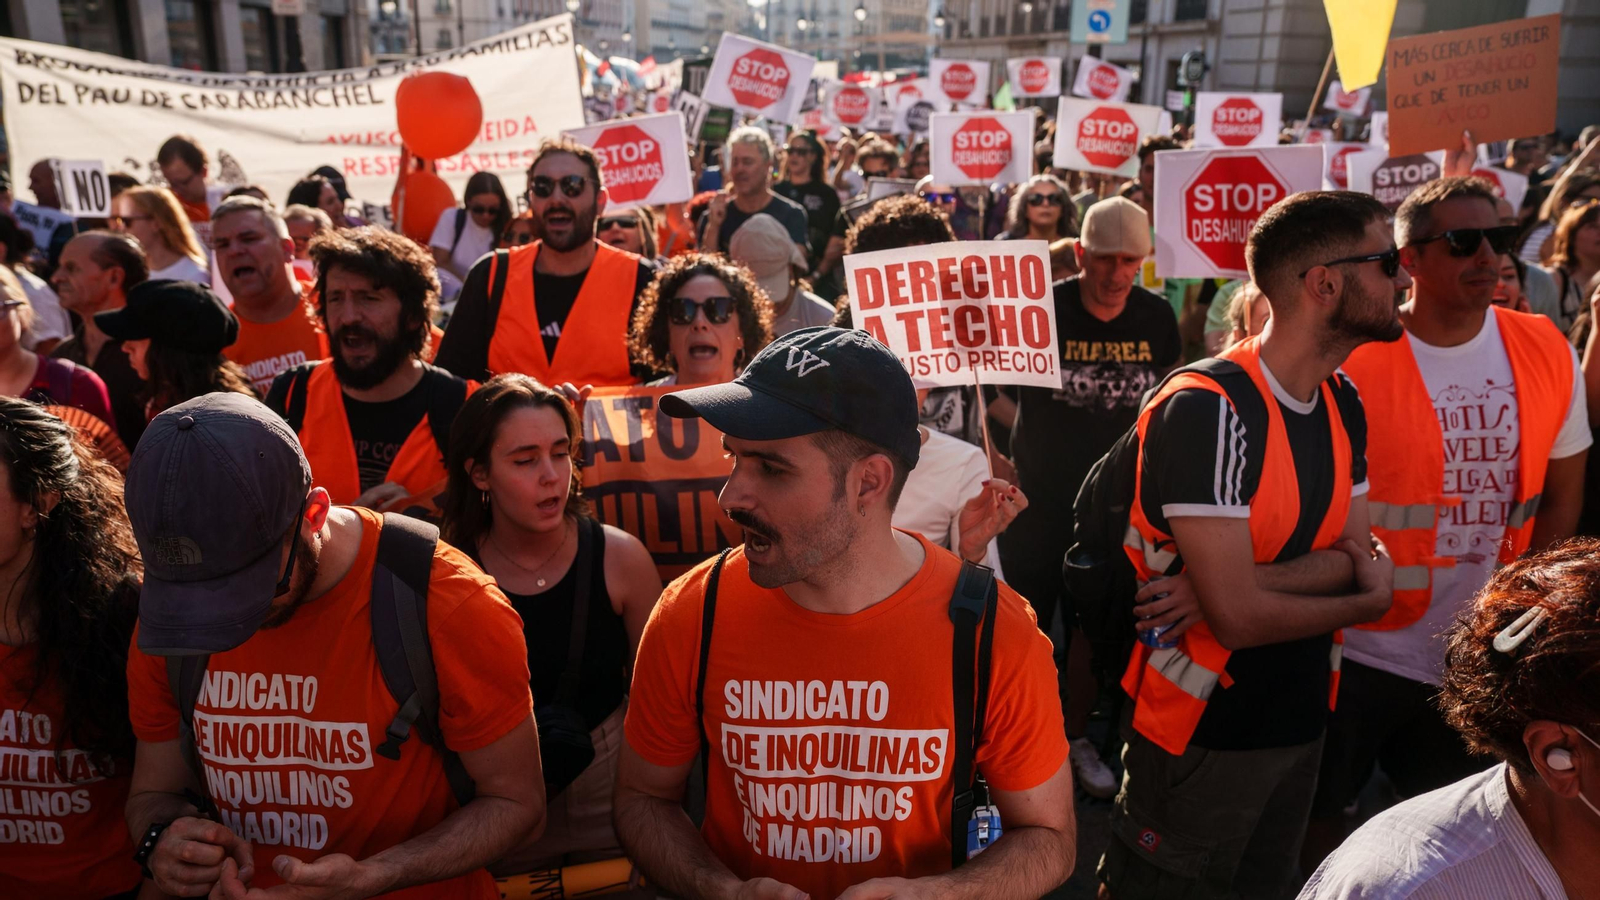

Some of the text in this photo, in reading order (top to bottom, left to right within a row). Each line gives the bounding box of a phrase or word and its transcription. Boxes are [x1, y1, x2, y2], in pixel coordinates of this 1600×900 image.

[450, 22, 570, 60] AMILIAS
[1431, 37, 1476, 62] CERCA
[1479, 36, 1494, 54] DE
[1500, 25, 1550, 50] SUFRIR
[736, 58, 788, 82] STOP
[1413, 70, 1436, 87] UN
[18, 82, 385, 110] DEL PAU DE CARABANCHEL
[1394, 76, 1529, 110] QUE DE TENER UN
[480, 115, 537, 142] EIDA
[1082, 119, 1135, 139] STOP
[1216, 108, 1260, 122] STOP
[594, 139, 655, 168] STOP
[956, 130, 1009, 148] STOP
[602, 162, 661, 187] ESAHUCIOS
[1375, 163, 1436, 186] STOP
[72, 168, 106, 212] NO
[1193, 183, 1277, 212] STOP
[854, 254, 1046, 311] DERECHO
[895, 304, 1052, 353] TECHO
[900, 350, 1055, 377] USTO PRECIO!
[1064, 340, 1152, 361] MAREA
[198, 669, 318, 714] INDICATO
[724, 679, 890, 721] SINDICATO
[212, 721, 367, 764] INQUILINAS
[726, 730, 942, 776] DE INQUILINAS
[734, 771, 914, 822] E INQUILINOS
[743, 805, 882, 864] DE MADRID
